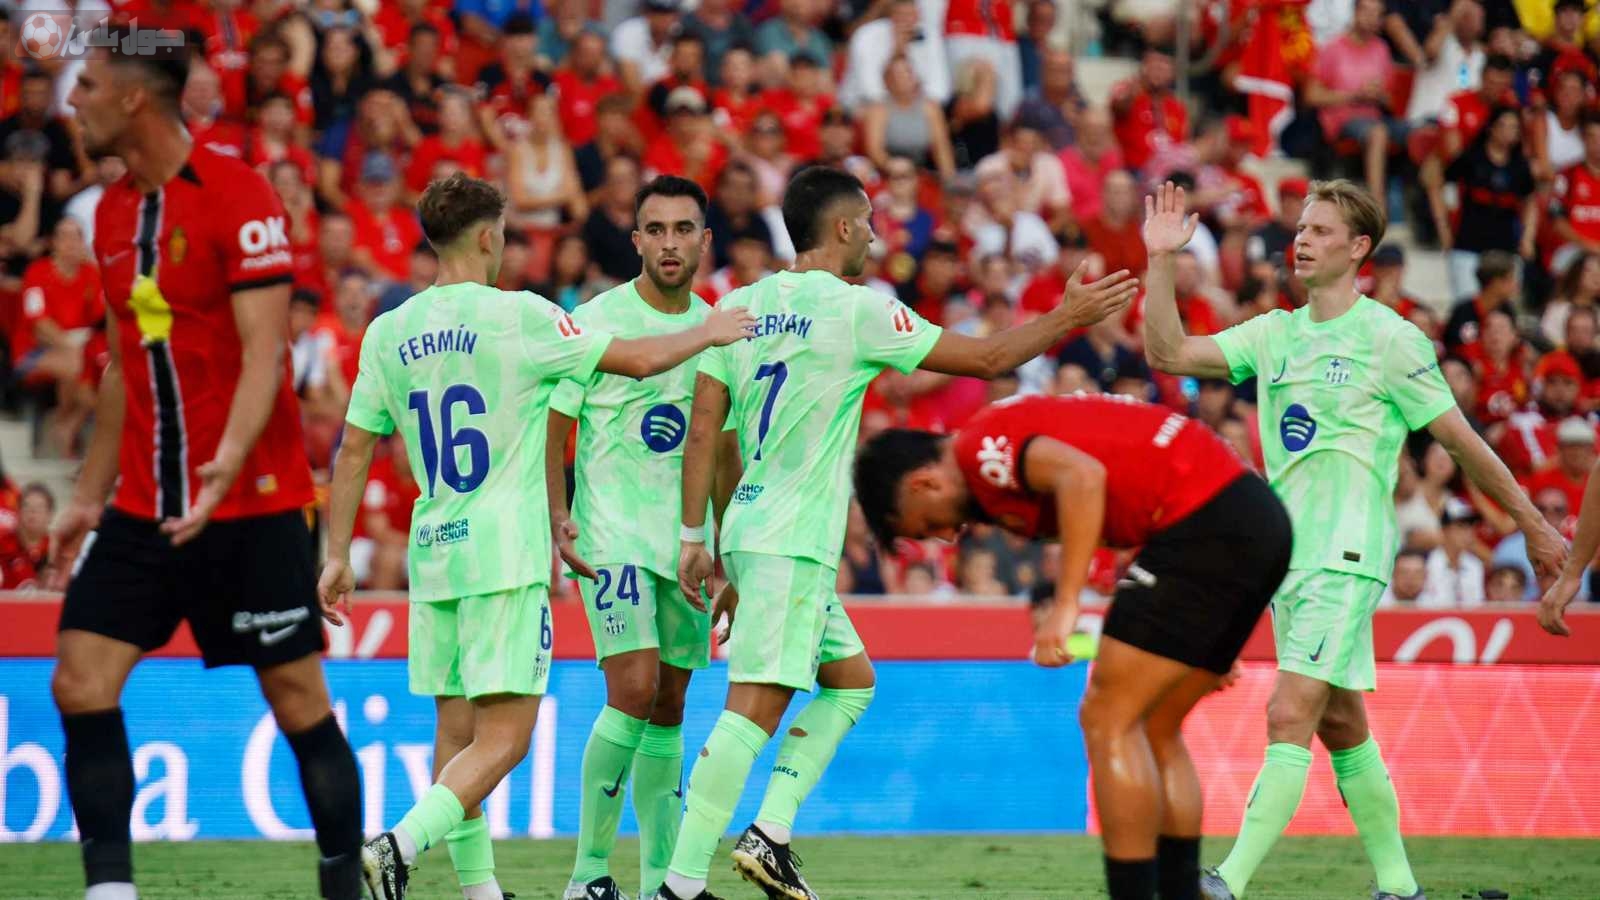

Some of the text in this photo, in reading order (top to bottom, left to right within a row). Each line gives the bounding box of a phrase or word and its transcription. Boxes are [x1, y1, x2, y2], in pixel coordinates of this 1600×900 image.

[239, 216, 288, 255] OK
[398, 324, 477, 366] FERMÍN
[745, 313, 812, 342] ERRAN
[753, 360, 788, 461] 7
[408, 384, 490, 498] 16
[735, 483, 765, 493] NHCR
[593, 564, 640, 611] 24
[0, 695, 199, 842] ba
